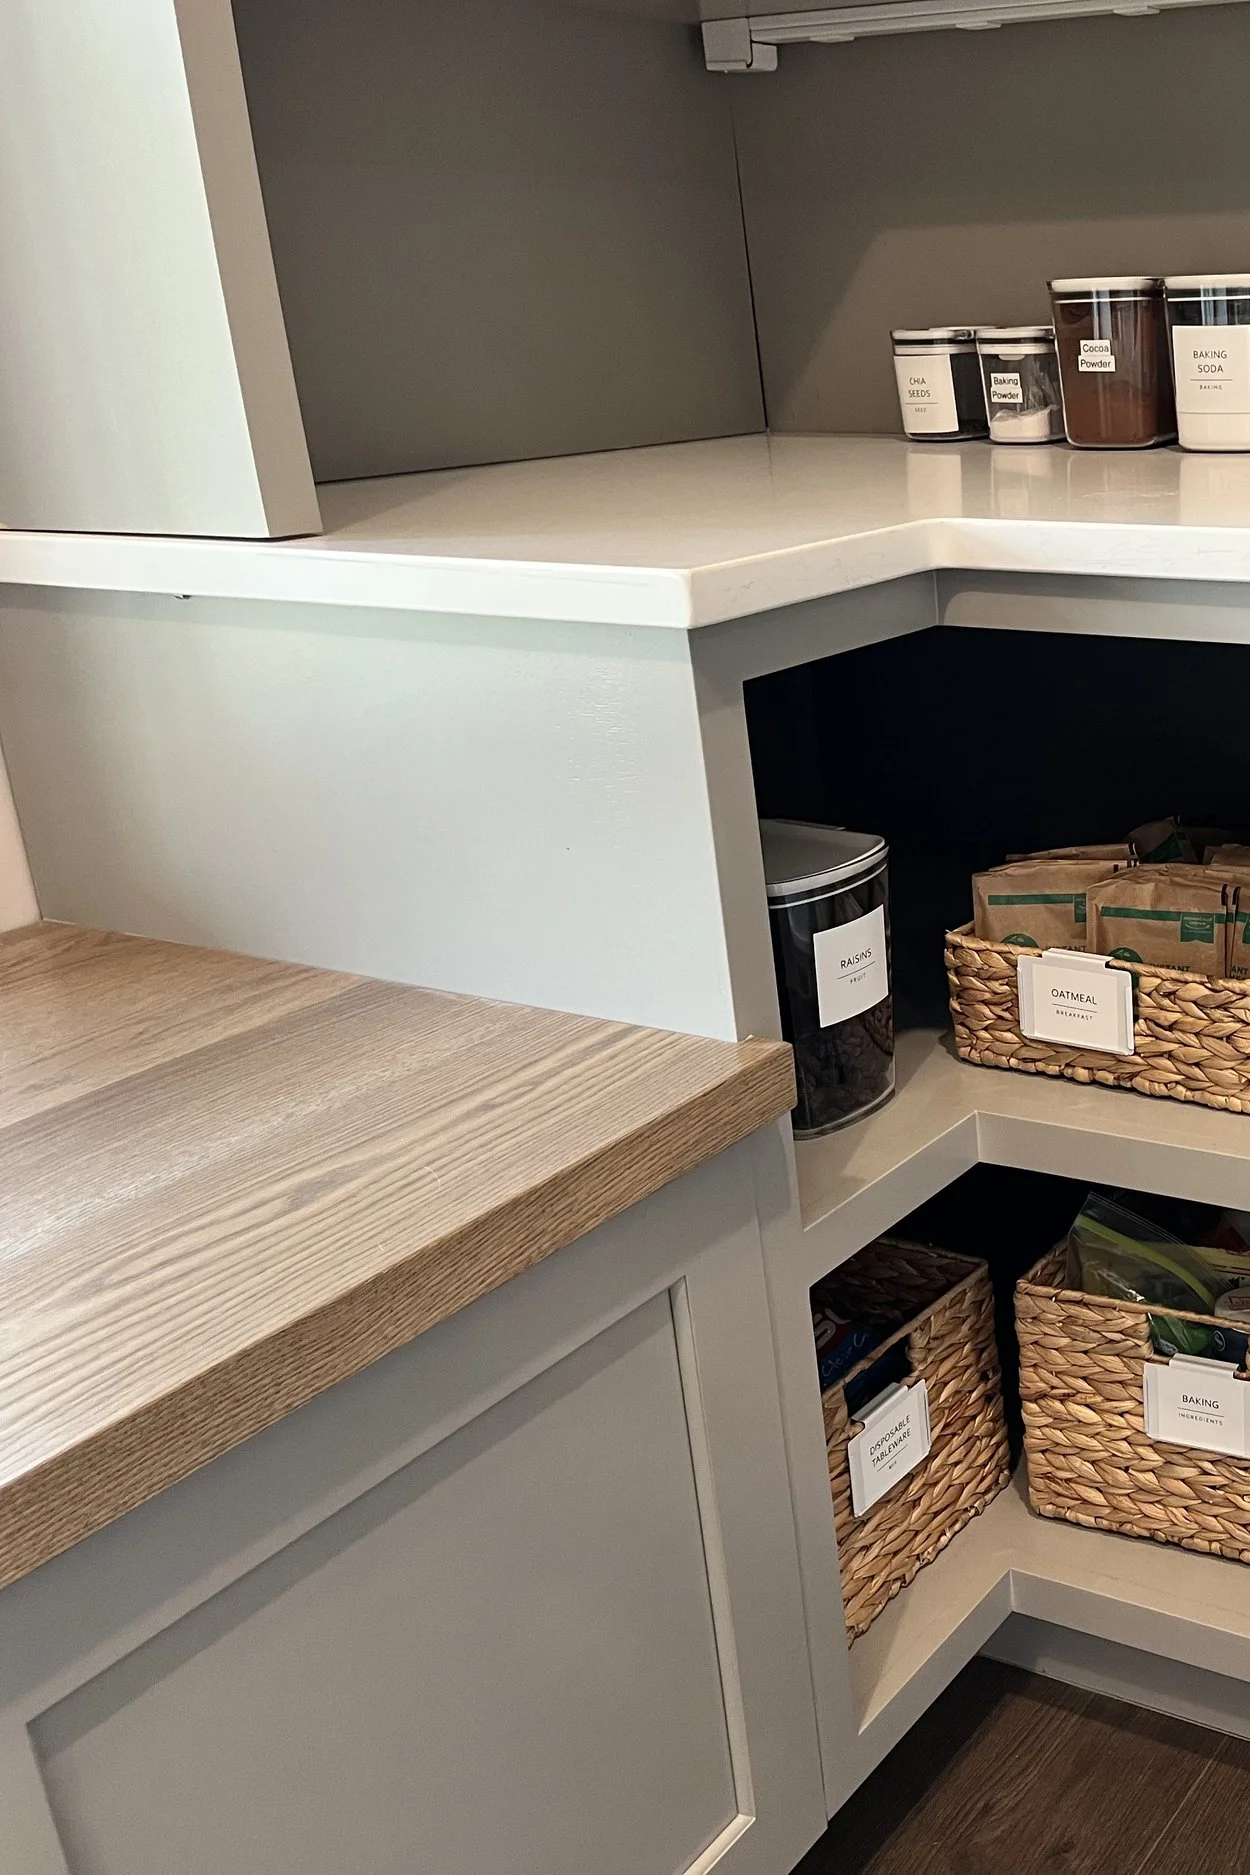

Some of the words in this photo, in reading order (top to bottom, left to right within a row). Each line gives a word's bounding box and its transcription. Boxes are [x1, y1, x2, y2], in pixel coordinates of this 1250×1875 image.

[1082, 343, 1109, 353] Cocoa
[1193, 350, 1228, 359] BAKING
[1080, 358, 1111, 369] Powder
[1197, 364, 1224, 374] SODA
[909, 377, 927, 386] CHIA
[993, 376, 1019, 387] Baking
[908, 389, 931, 398] SEEDS
[992, 390, 1019, 401] Powder
[840, 947, 872, 970] RAISINS
[850, 972, 866, 984] FRUIT
[1051, 988, 1098, 1005] OATMEAL
[1056, 1009, 1093, 1021] BREAKFAST
[1182, 1394, 1220, 1410] BAKING
[1178, 1412, 1223, 1426] INGREDIENTS
[869, 1414, 911, 1456] DISPOSABLE
[871, 1428, 911, 1467] TABLEWARE
